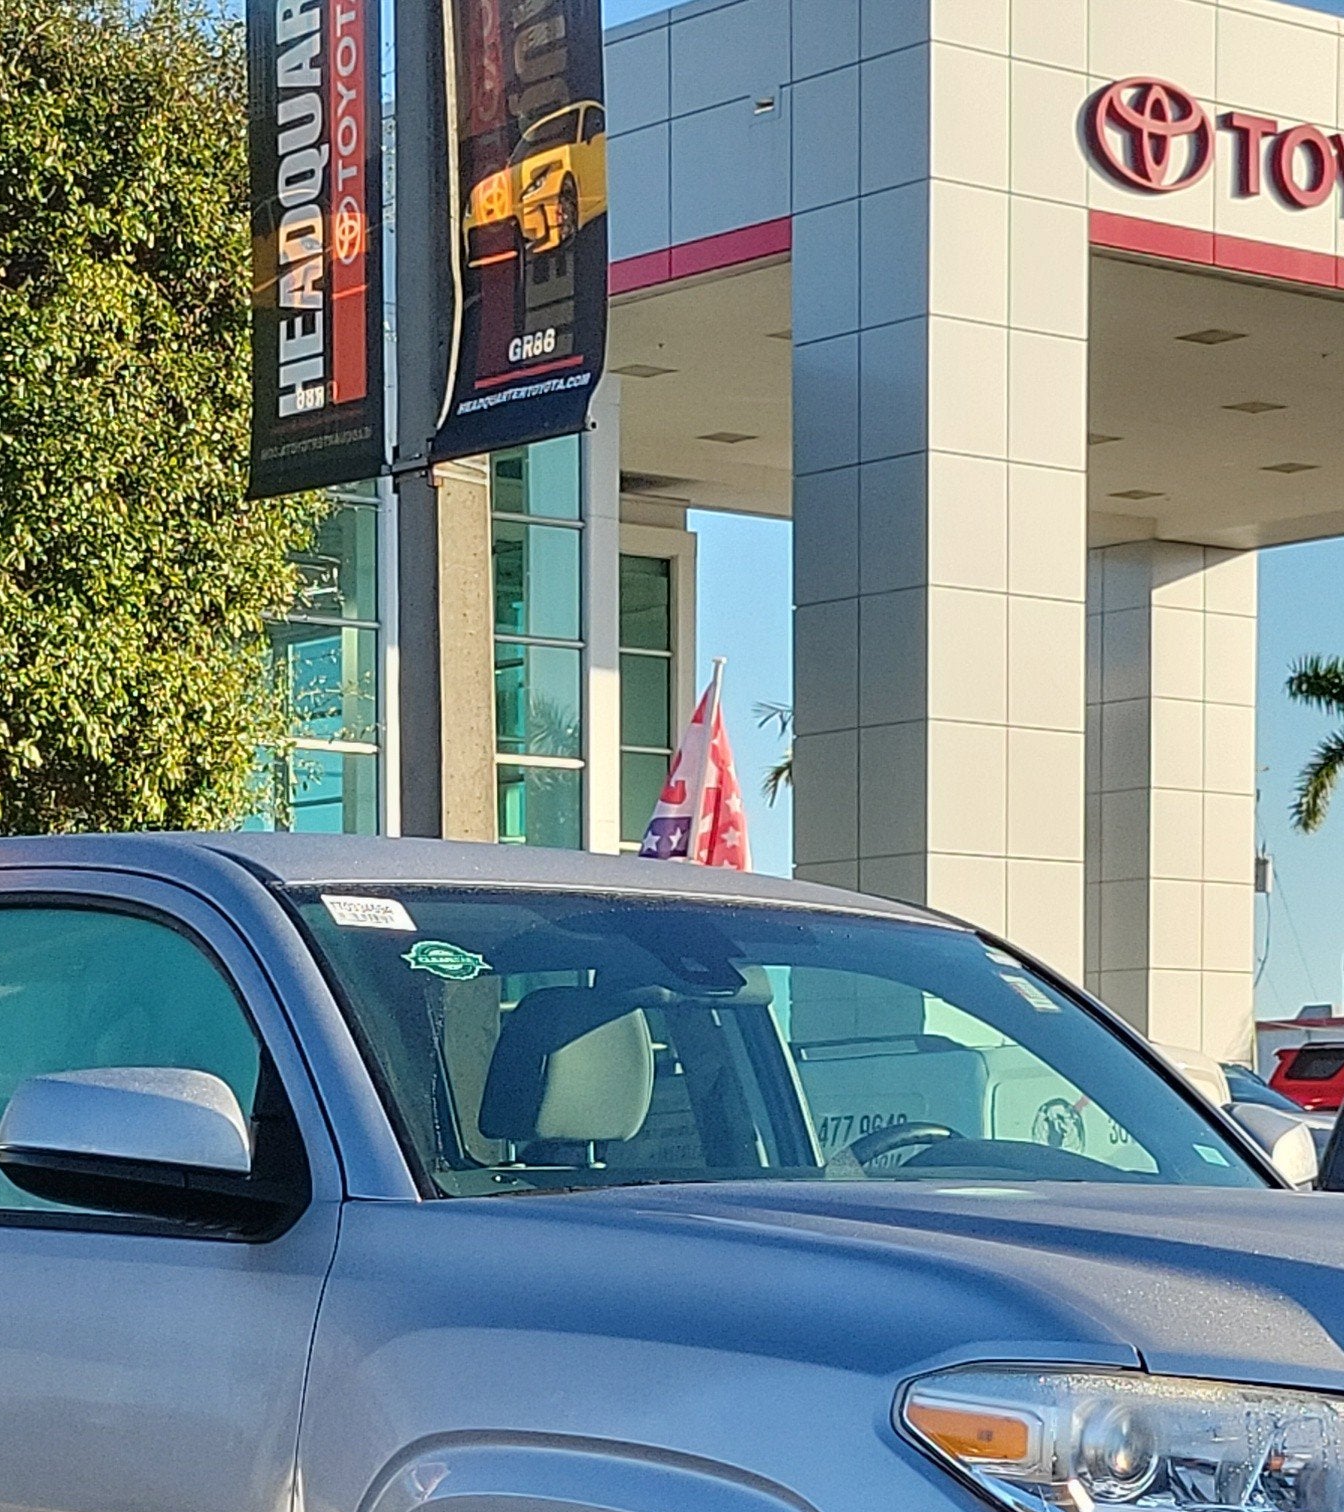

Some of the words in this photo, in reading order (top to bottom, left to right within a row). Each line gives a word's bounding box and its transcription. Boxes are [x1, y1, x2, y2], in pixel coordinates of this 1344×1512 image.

[336, 0, 358, 189] TOYOT
[508, 327, 556, 362] GR86
[1108, 1118, 1136, 1145] 30
